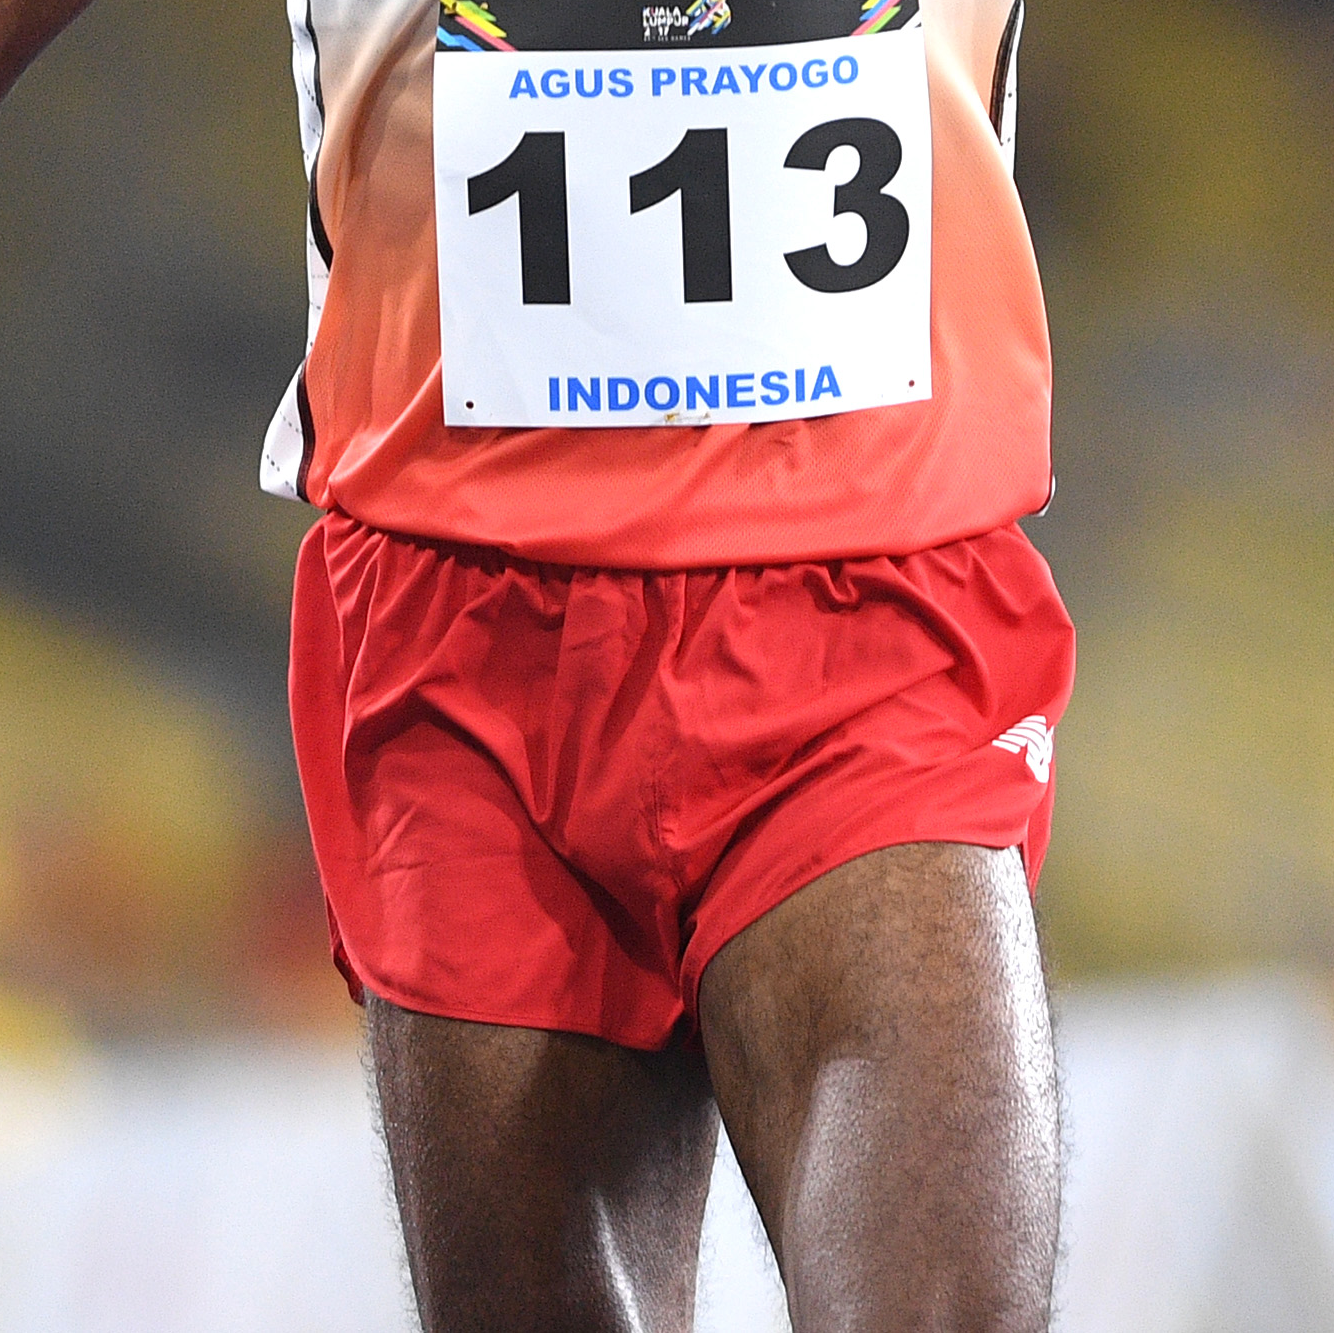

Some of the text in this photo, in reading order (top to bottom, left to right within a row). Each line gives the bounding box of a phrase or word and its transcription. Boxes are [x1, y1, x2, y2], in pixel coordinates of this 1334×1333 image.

[508, 54, 859, 100] AGUS PRAYOGO
[466, 117, 910, 306] 113
[548, 364, 843, 413] INDONESIA
